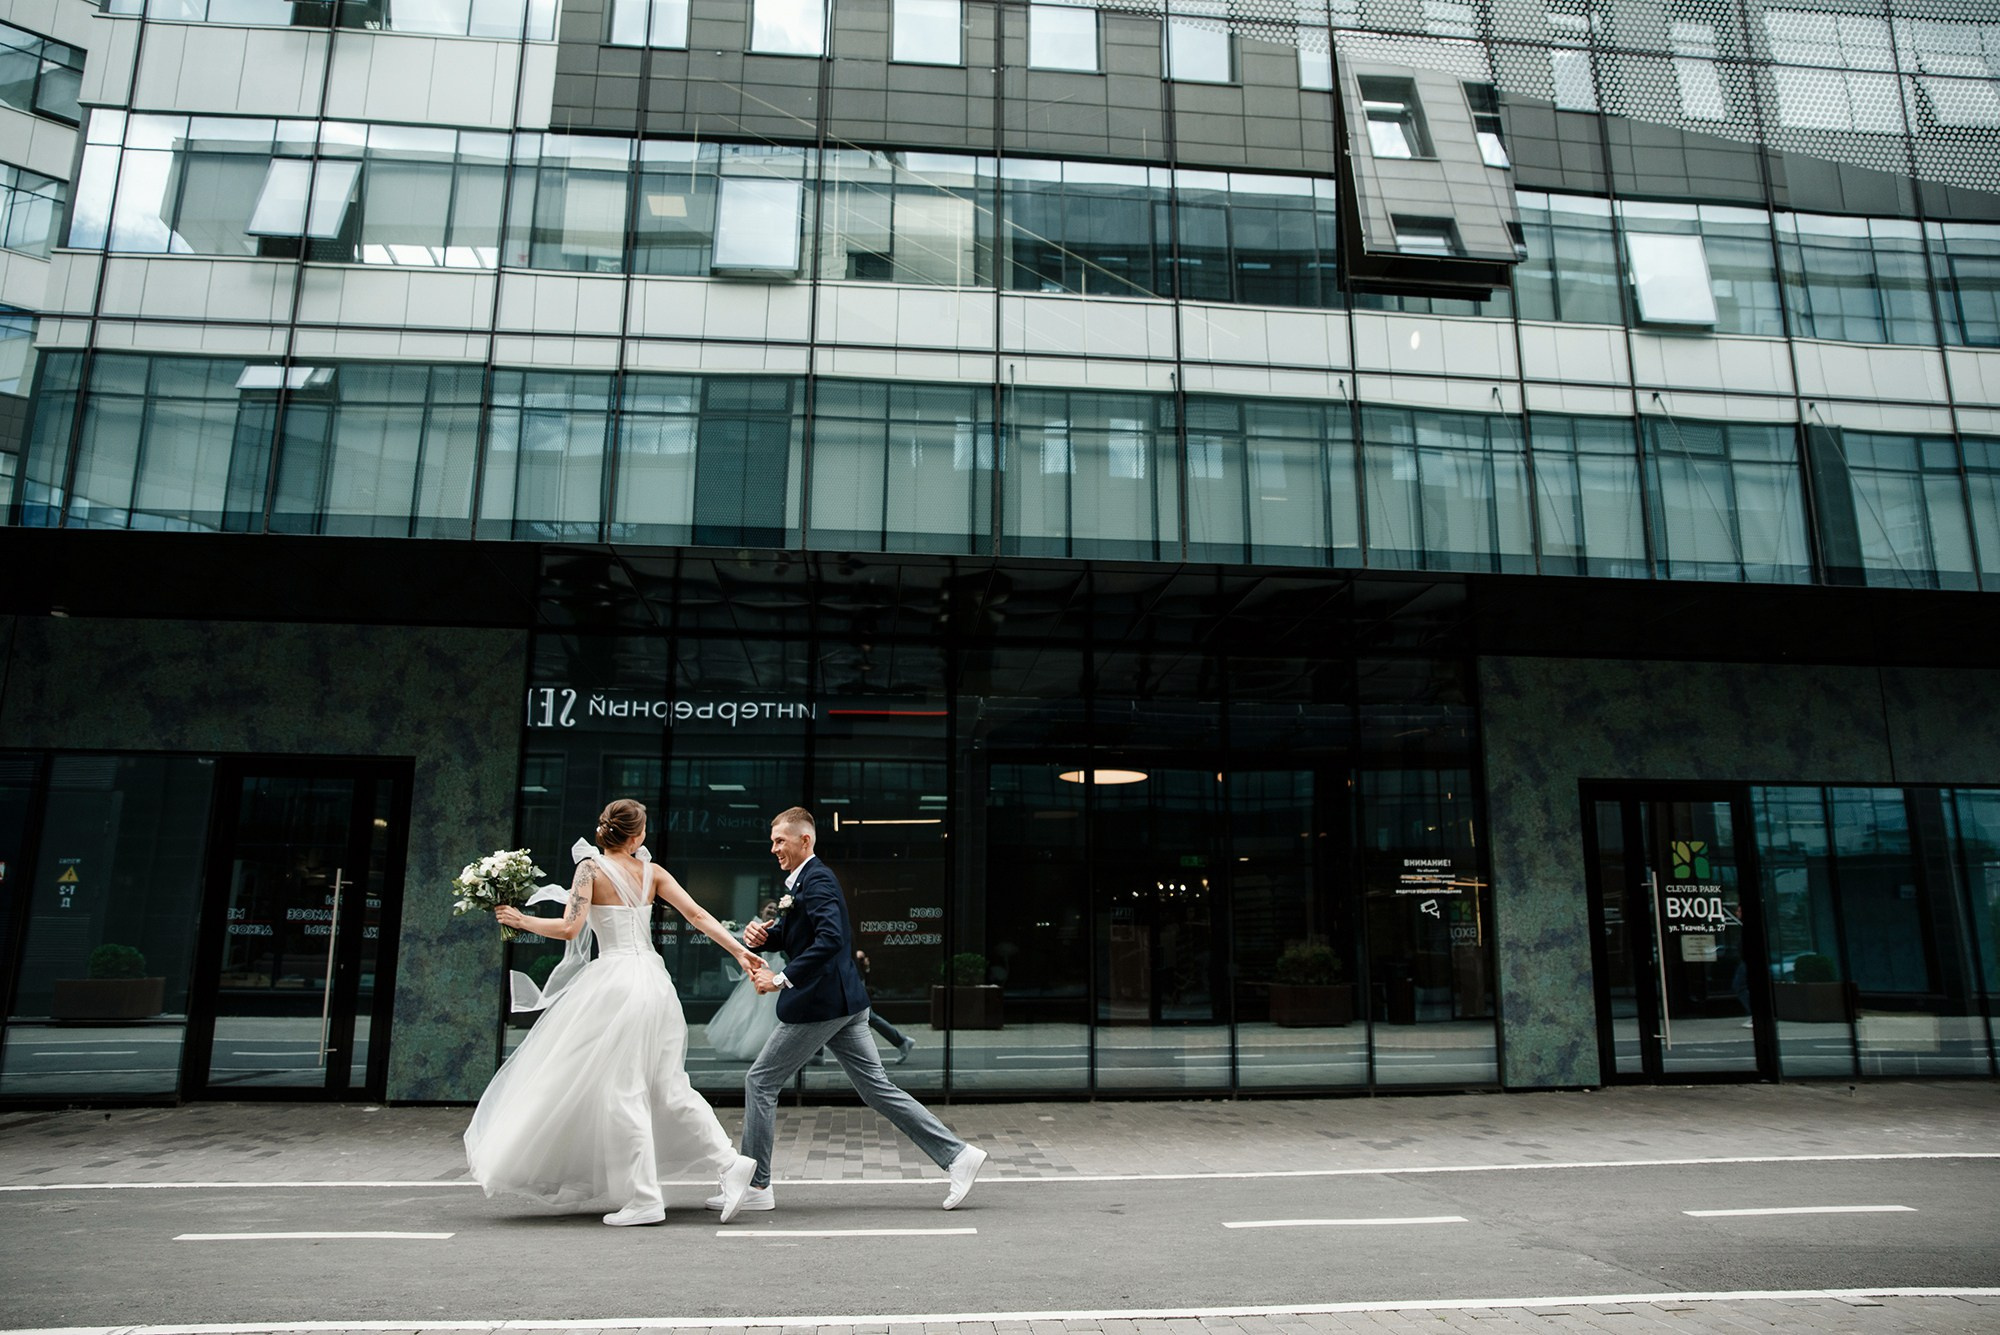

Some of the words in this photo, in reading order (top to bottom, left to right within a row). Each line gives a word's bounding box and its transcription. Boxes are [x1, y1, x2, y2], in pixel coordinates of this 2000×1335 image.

[1403, 859, 1451, 867] ВНИМАНИЕ!
[1665, 885, 1698, 893] CLEVER
[1699, 885, 1721, 893] PARK
[1666, 897, 1725, 922] ВХОД
